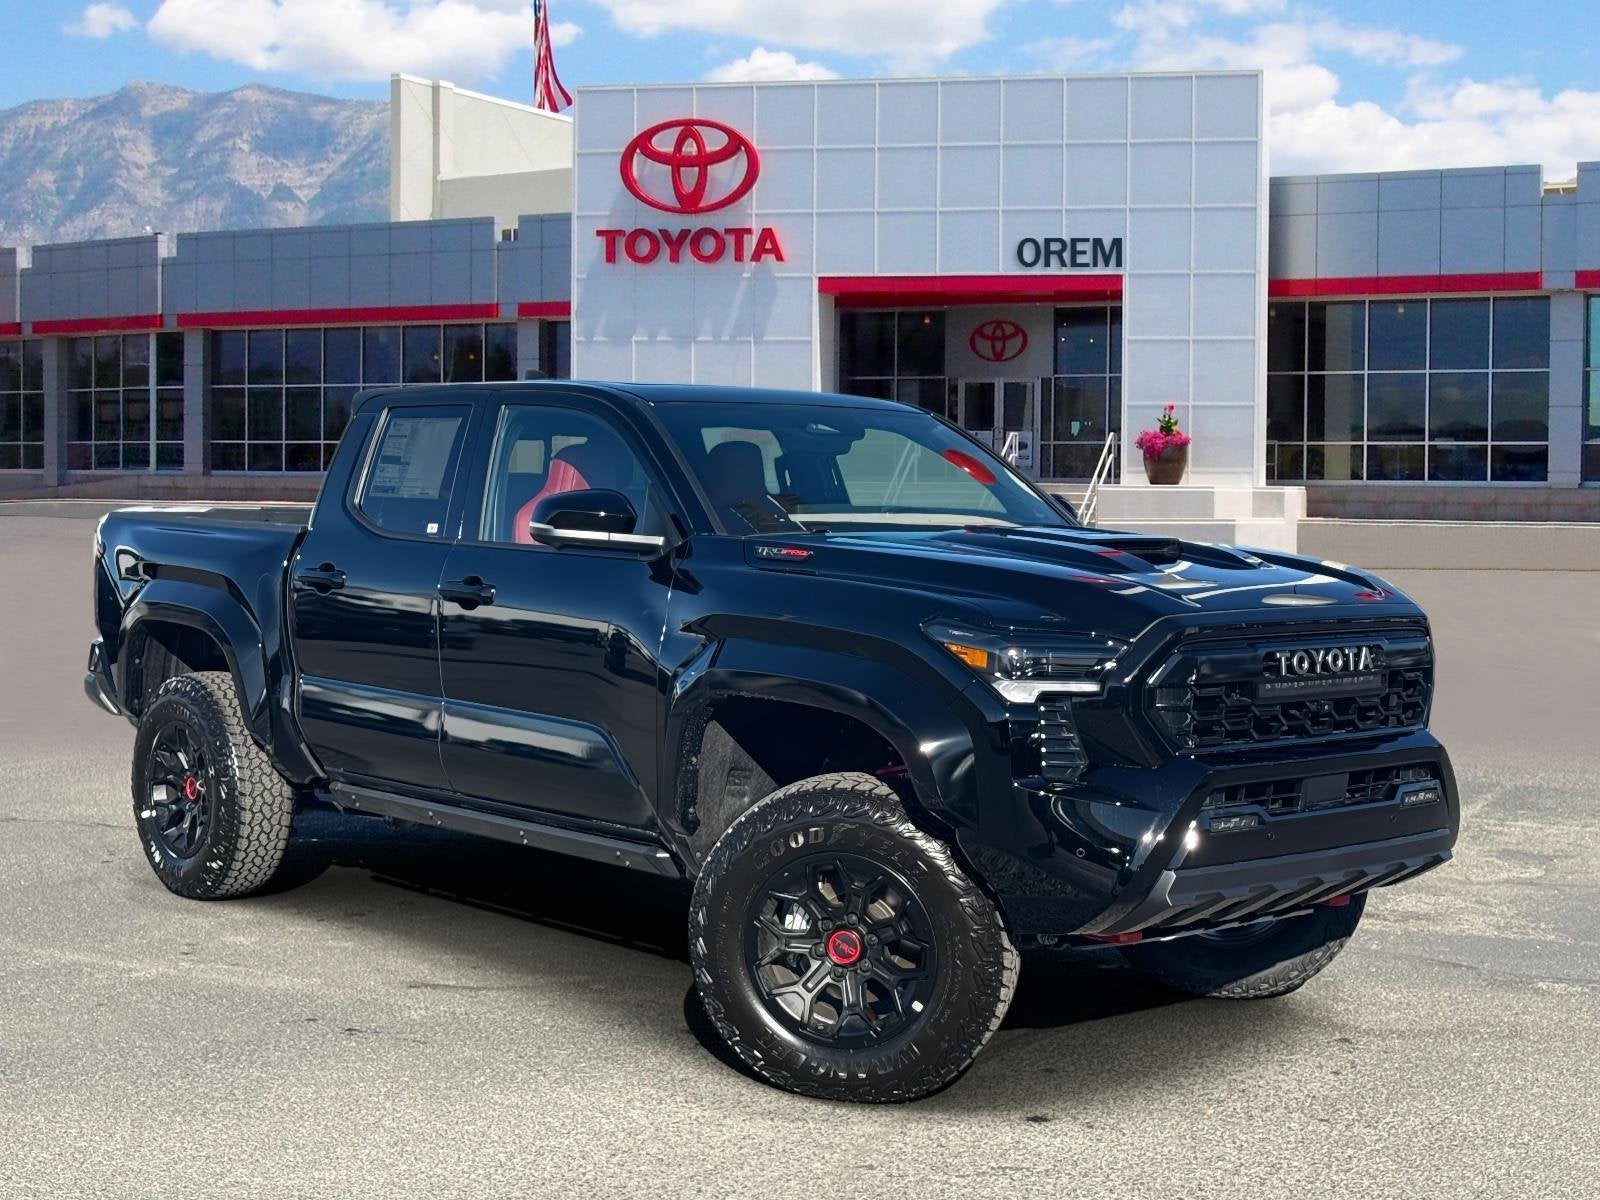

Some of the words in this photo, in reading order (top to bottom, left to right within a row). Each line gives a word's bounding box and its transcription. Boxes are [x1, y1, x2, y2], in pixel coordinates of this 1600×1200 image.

[595, 227, 785, 264] TOYOTA
[1017, 237, 1123, 268] OREM
[1276, 646, 1375, 676] TOYOTA
